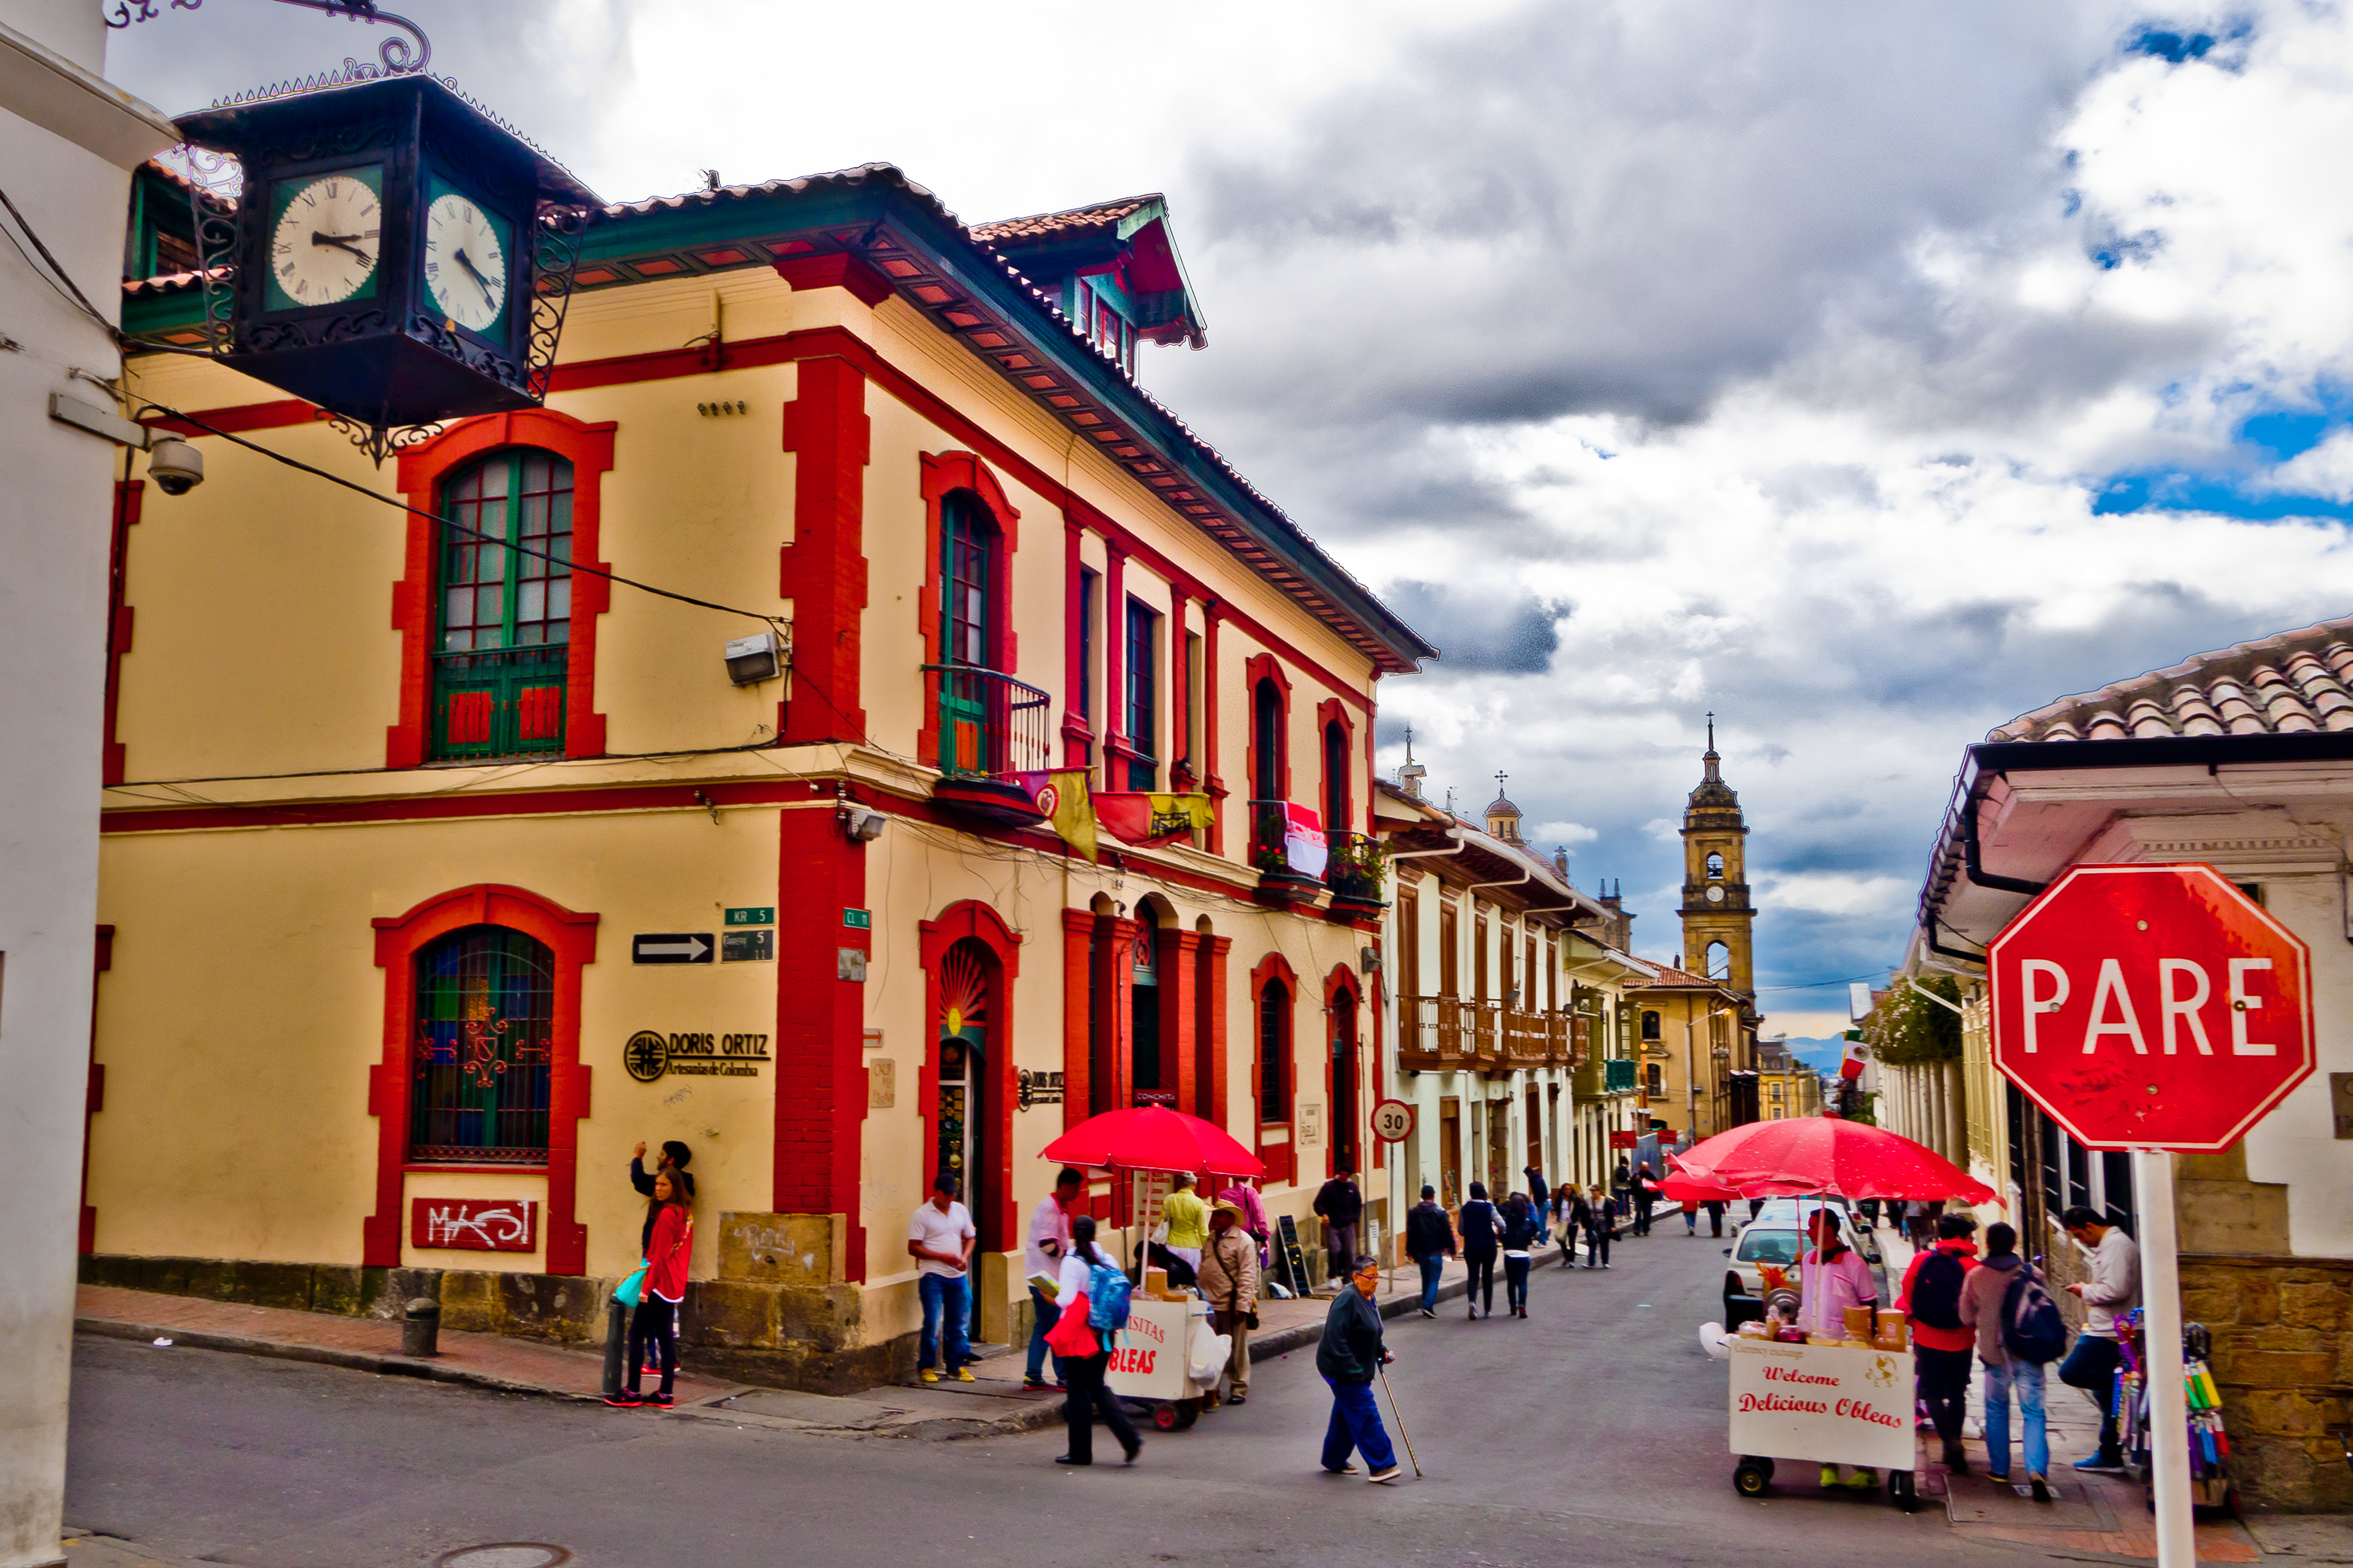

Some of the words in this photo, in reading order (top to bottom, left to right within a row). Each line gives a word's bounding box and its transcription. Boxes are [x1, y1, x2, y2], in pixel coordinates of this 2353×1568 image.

[734, 911, 747, 922] KR
[759, 909, 766, 922] 5
[757, 931, 765, 944] 5
[2021, 958, 2277, 1056] PARE
[669, 1033, 714, 1054] DORIS
[722, 1034, 768, 1055] ORTIZ
[709, 1061, 719, 1076] de
[1383, 1113, 1403, 1130] 30
[1109, 1346, 1157, 1374] BLEAS
[1762, 1365, 1840, 1386] Welcome
[1739, 1392, 1828, 1414] Delicious
[1835, 1398, 1902, 1429] Obleas
